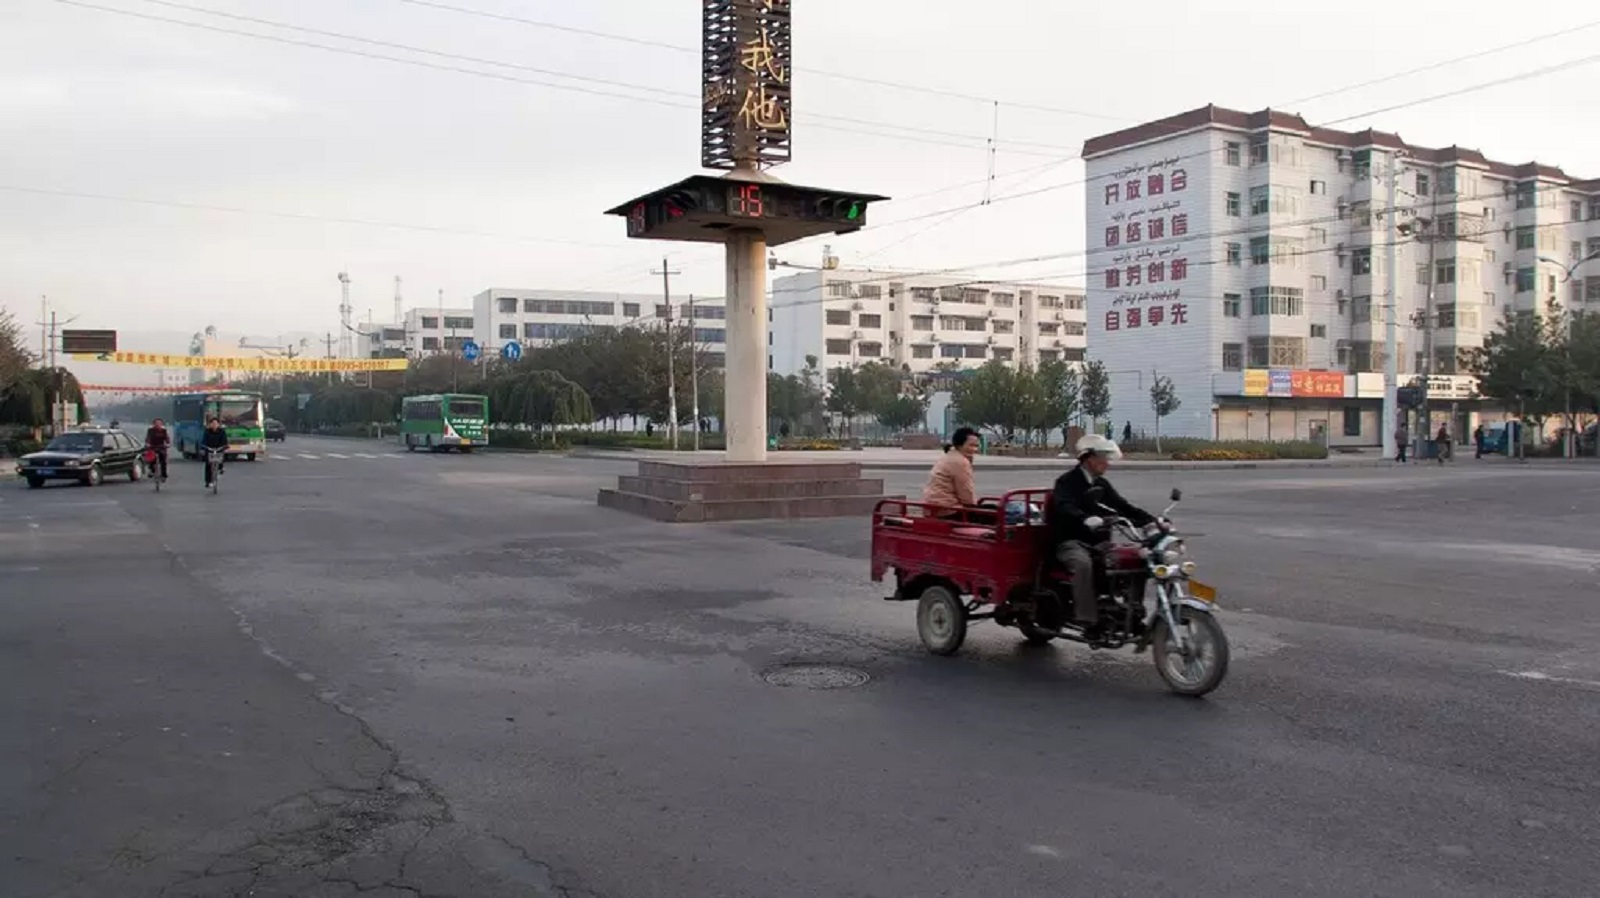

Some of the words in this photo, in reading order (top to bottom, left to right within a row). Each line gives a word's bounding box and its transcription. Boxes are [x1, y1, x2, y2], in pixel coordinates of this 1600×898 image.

[739, 185, 763, 217] 15
[1105, 169, 1187, 205] 开放融合
[1105, 213, 1188, 247] 团结诚信
[1105, 303, 1188, 331] 自强争先
